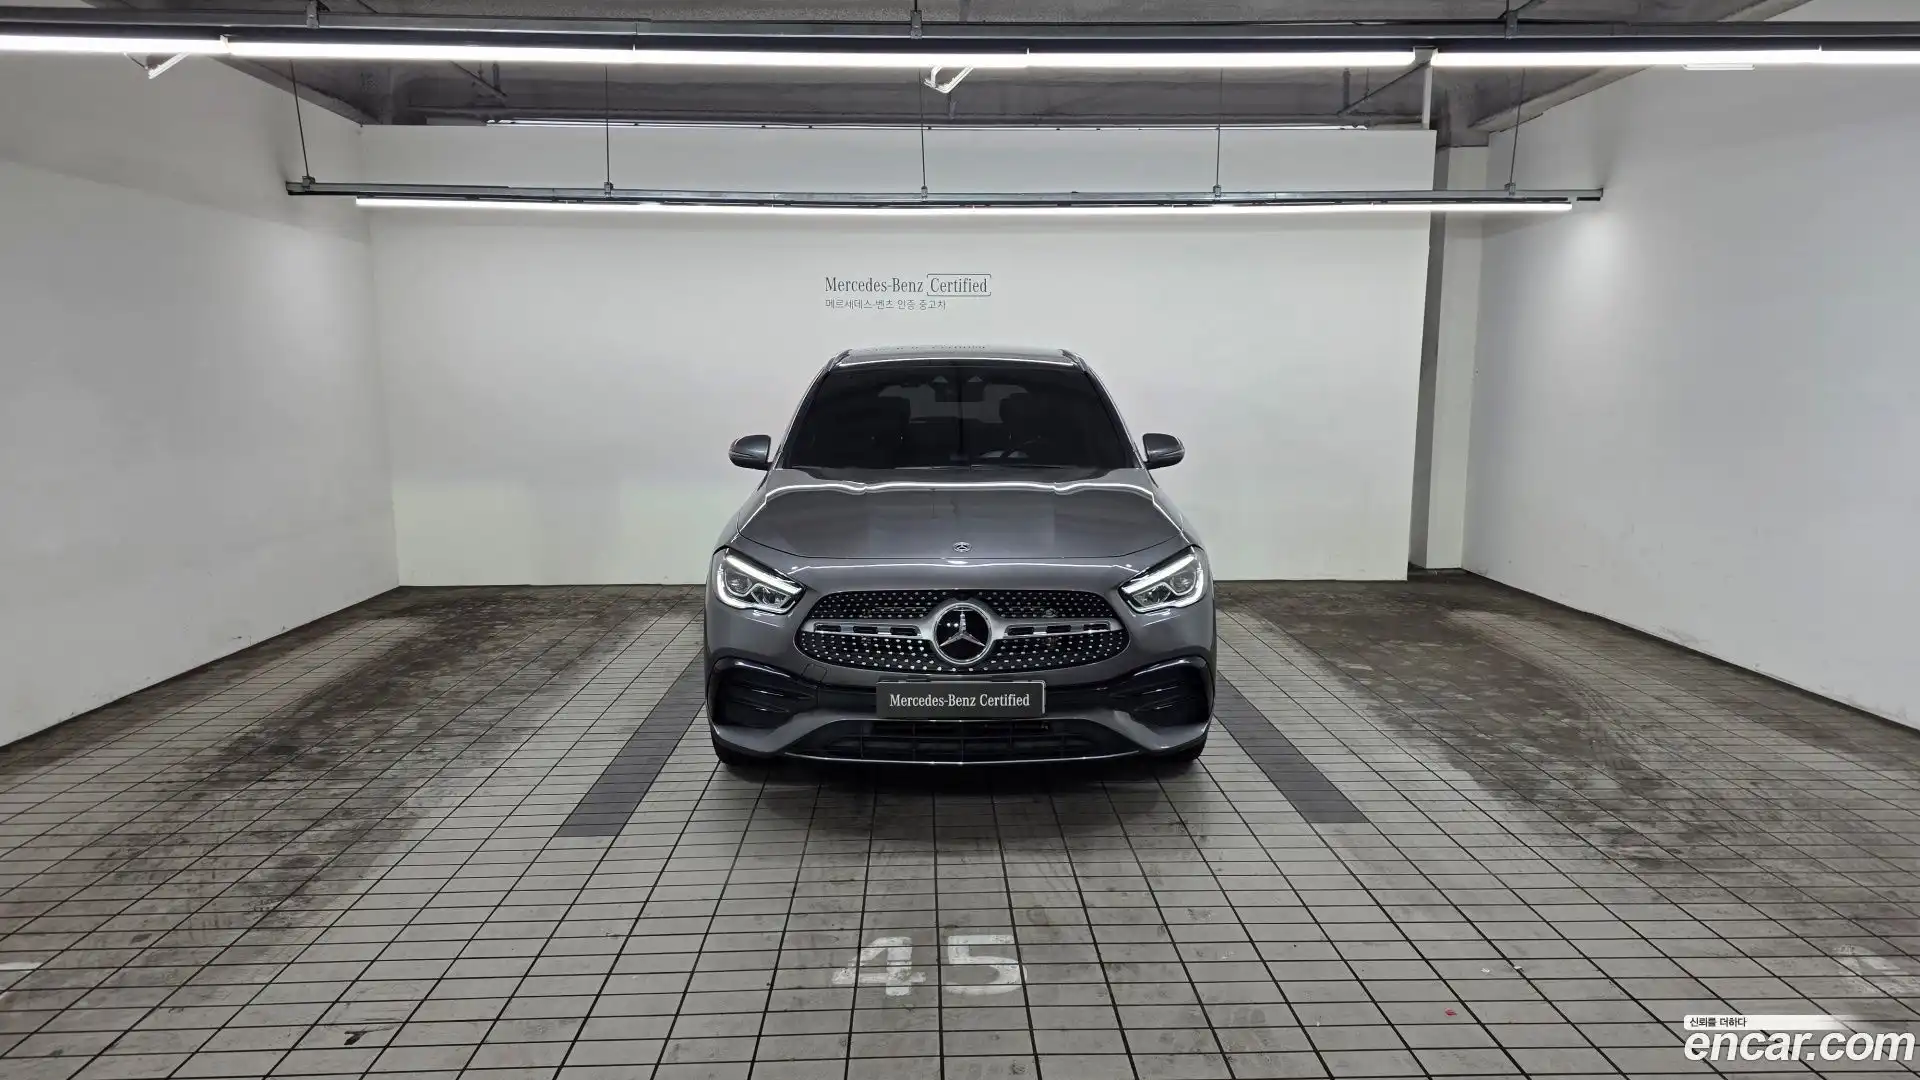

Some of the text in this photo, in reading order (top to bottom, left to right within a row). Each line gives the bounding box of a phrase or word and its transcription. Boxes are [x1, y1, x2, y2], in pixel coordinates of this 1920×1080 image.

[825, 277, 987, 293] Mercedes-Benz Certified
[897, 299, 915, 310] 인증
[919, 299, 946, 311] 중고차
[889, 694, 1030, 707] Mercedes-Benz Certified
[832, 935, 1027, 997] 45
